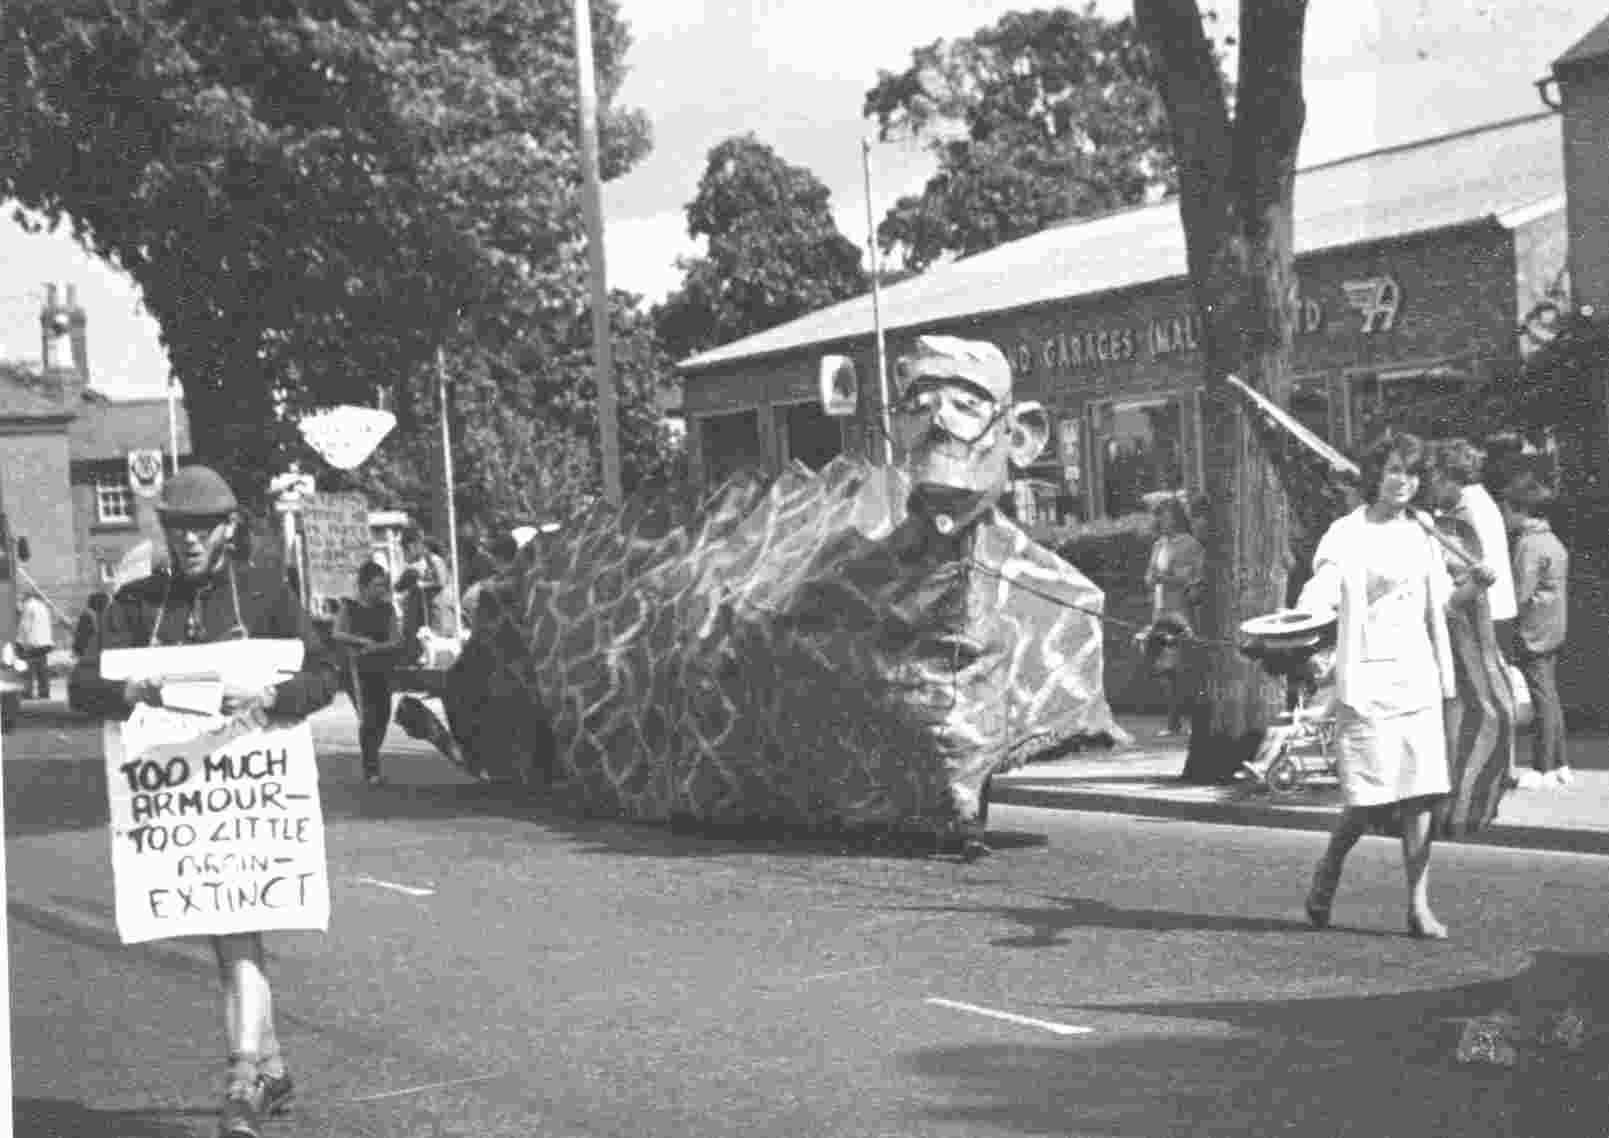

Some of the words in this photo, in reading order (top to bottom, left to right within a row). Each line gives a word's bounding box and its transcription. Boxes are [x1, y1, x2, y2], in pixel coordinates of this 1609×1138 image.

[1042, 330, 1135, 369] GARAGES
[1148, 313, 1202, 363] (MAL
[120, 756, 191, 792] TOO
[203, 747, 288, 783] MUCH
[127, 823, 198, 854] TOO
[208, 816, 311, 844] LITTLE
[148, 872, 316, 918] EXTINCT
